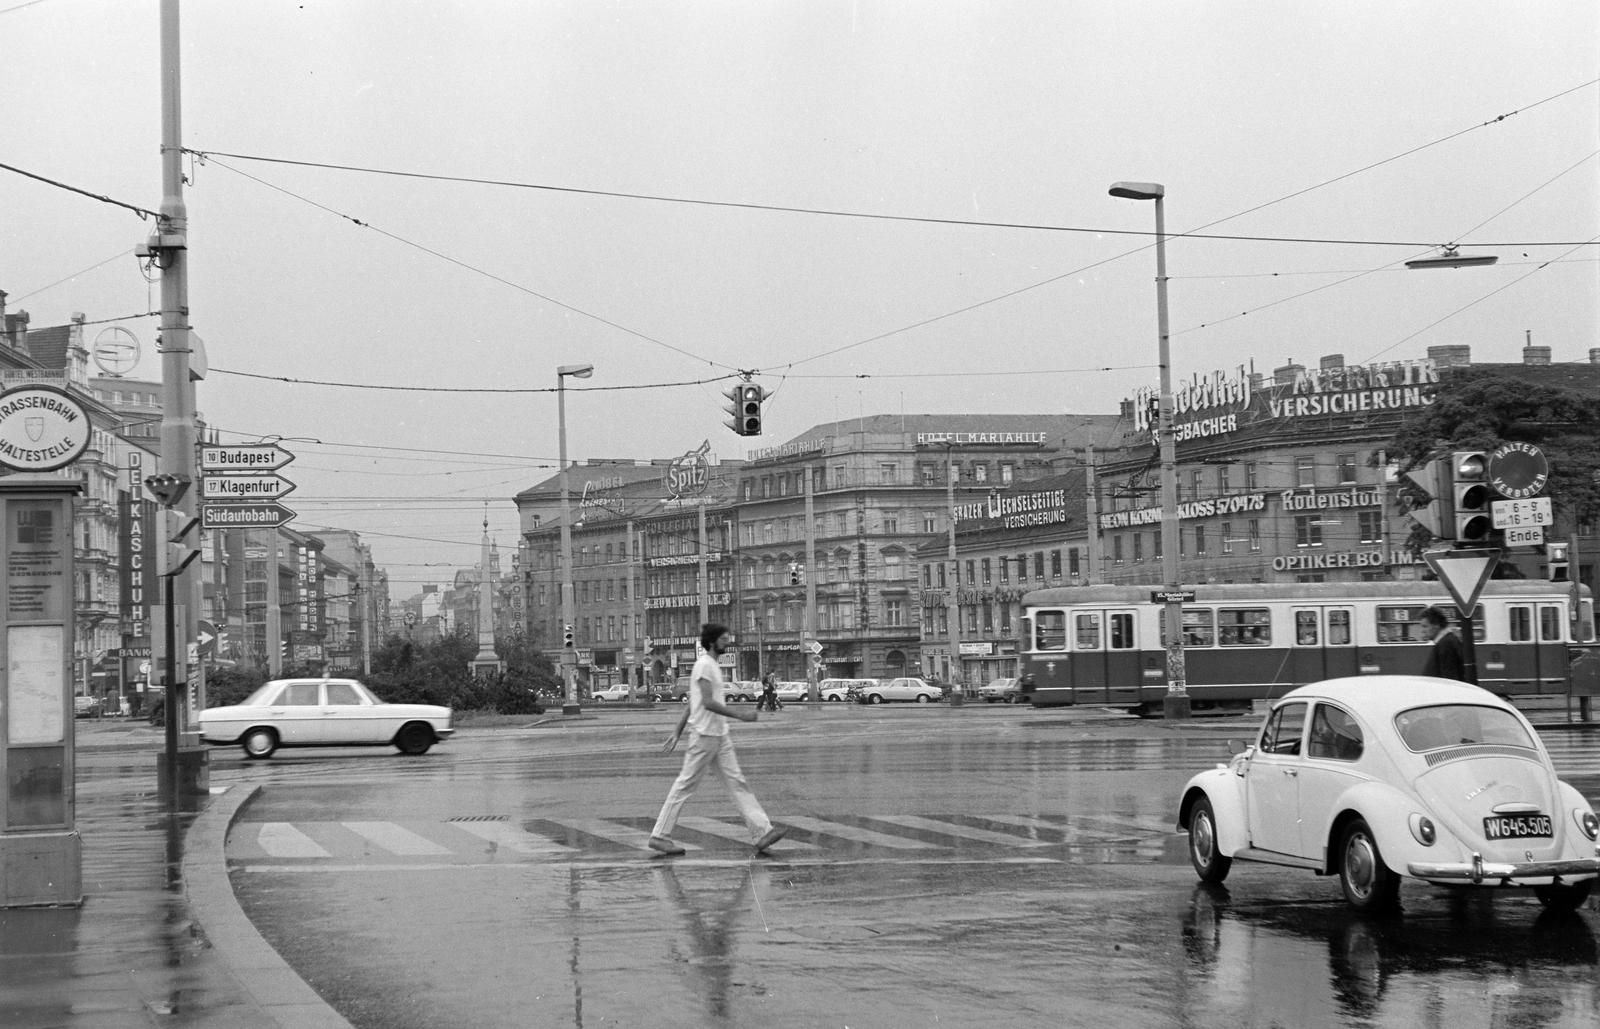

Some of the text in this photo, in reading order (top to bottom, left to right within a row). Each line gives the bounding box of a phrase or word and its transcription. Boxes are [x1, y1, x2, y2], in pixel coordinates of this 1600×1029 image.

[0, 396, 78, 423] TRASSENBAHN
[968, 432, 1047, 443] MARIAHILF
[1152, 414, 1238, 446] RSBACHER
[0, 436, 75, 462] HALTESTELLE
[207, 450, 276, 466] 10 Budapest
[1495, 442, 1538, 460] HALTEN
[208, 479, 280, 496] 17 Klagenfurt
[670, 465, 705, 492] Spitz
[1494, 474, 1546, 497] VERBOTEN
[206, 508, 279, 522] Südautobahn
[953, 489, 1066, 525] GRAZER WECHSELSEITIGE
[1100, 511, 1129, 529] NEON
[1177, 499, 1215, 520] KLOSS
[1004, 509, 1066, 529] VERSICHERUNG
[1510, 530, 1540, 542] Ende
[1272, 552, 1350, 571] OPTIKER
[119, 649, 151, 658] BANK
